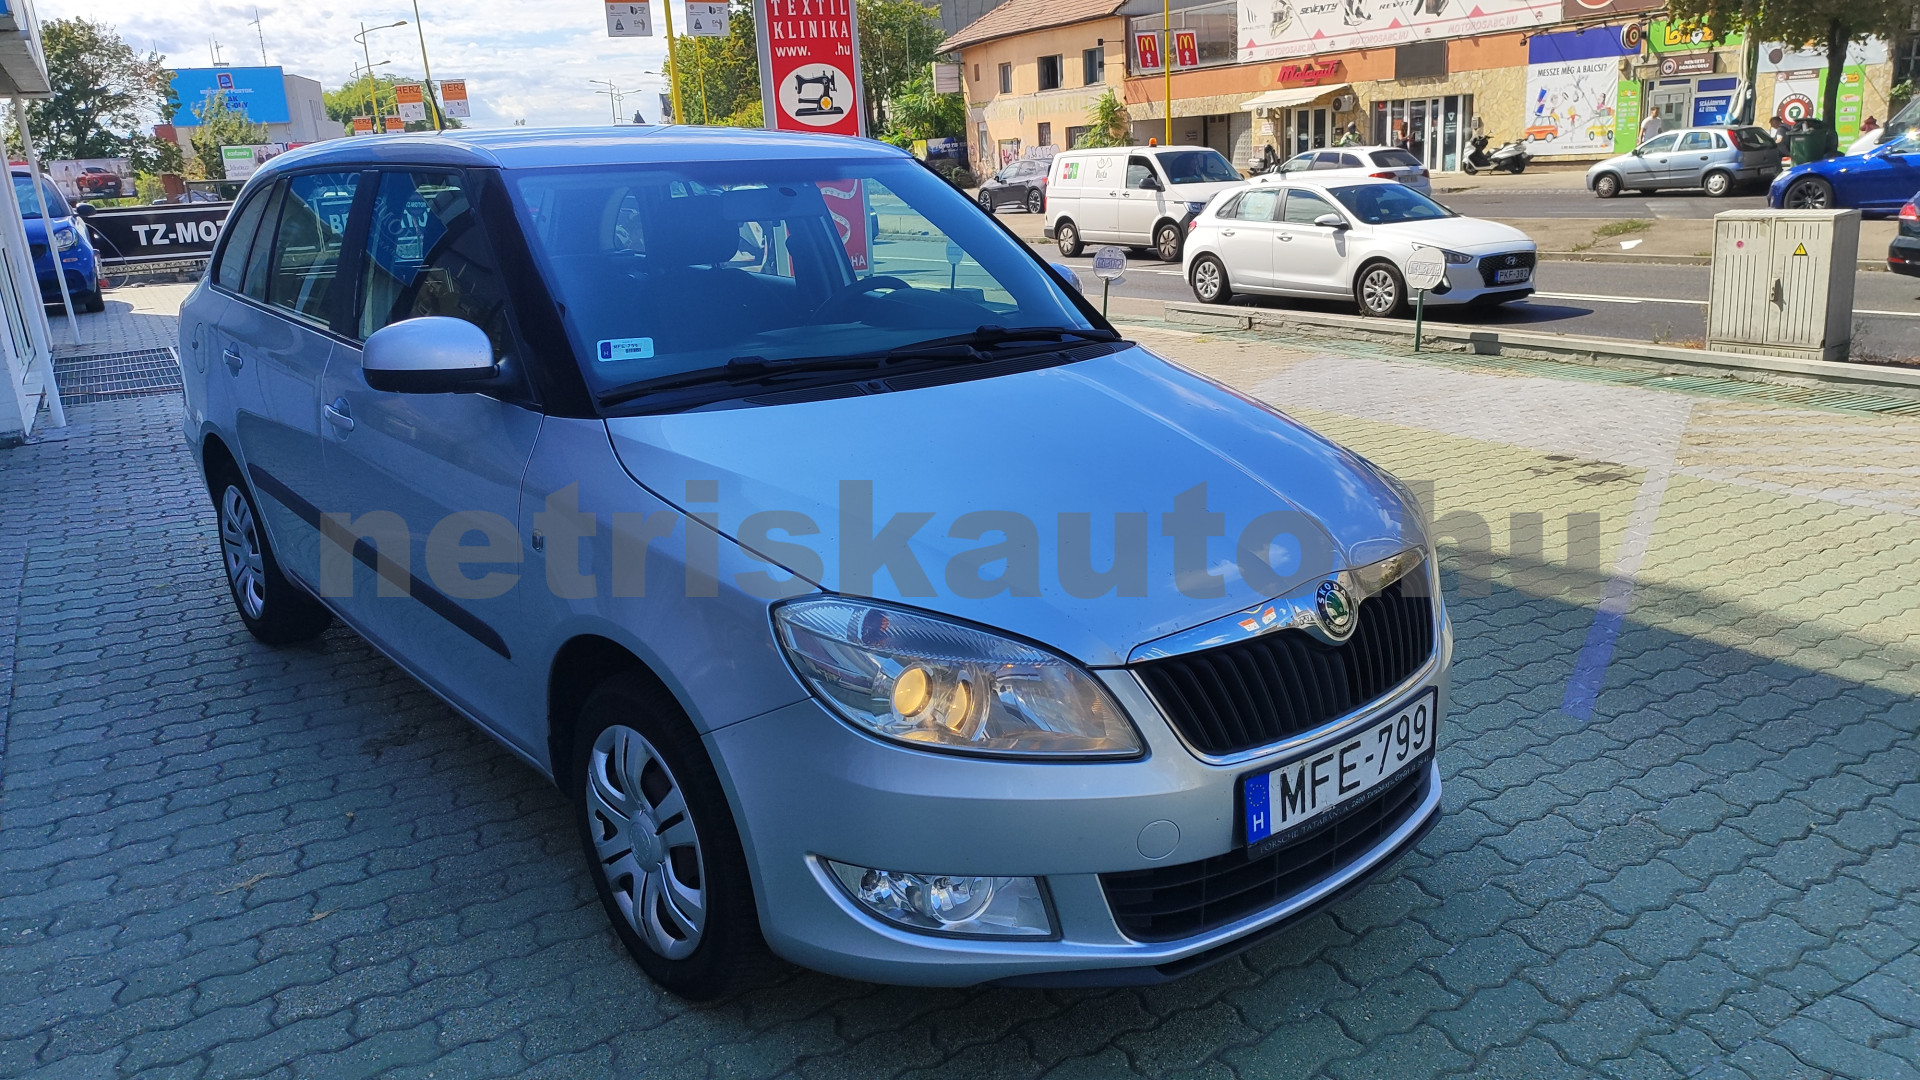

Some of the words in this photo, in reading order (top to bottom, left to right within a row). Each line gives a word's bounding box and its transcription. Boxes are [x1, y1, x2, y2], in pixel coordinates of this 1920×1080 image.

[771, 0, 847, 16] TEXTIL
[1300, 3, 1338, 15] SEVENTY
[773, 20, 849, 39] KLINIKA
[775, 45, 811, 58] www.
[834, 41, 851, 56] .hu
[1538, 67, 1560, 77] MESSZE
[1583, 63, 1608, 73] BALCSI?
[396, 85, 420, 95] HERZ
[441, 83, 465, 92] HERZ
[1499, 269, 1528, 279] PKF-382
[1279, 704, 1427, 823] MFE-799
[1252, 811, 1265, 833] H
